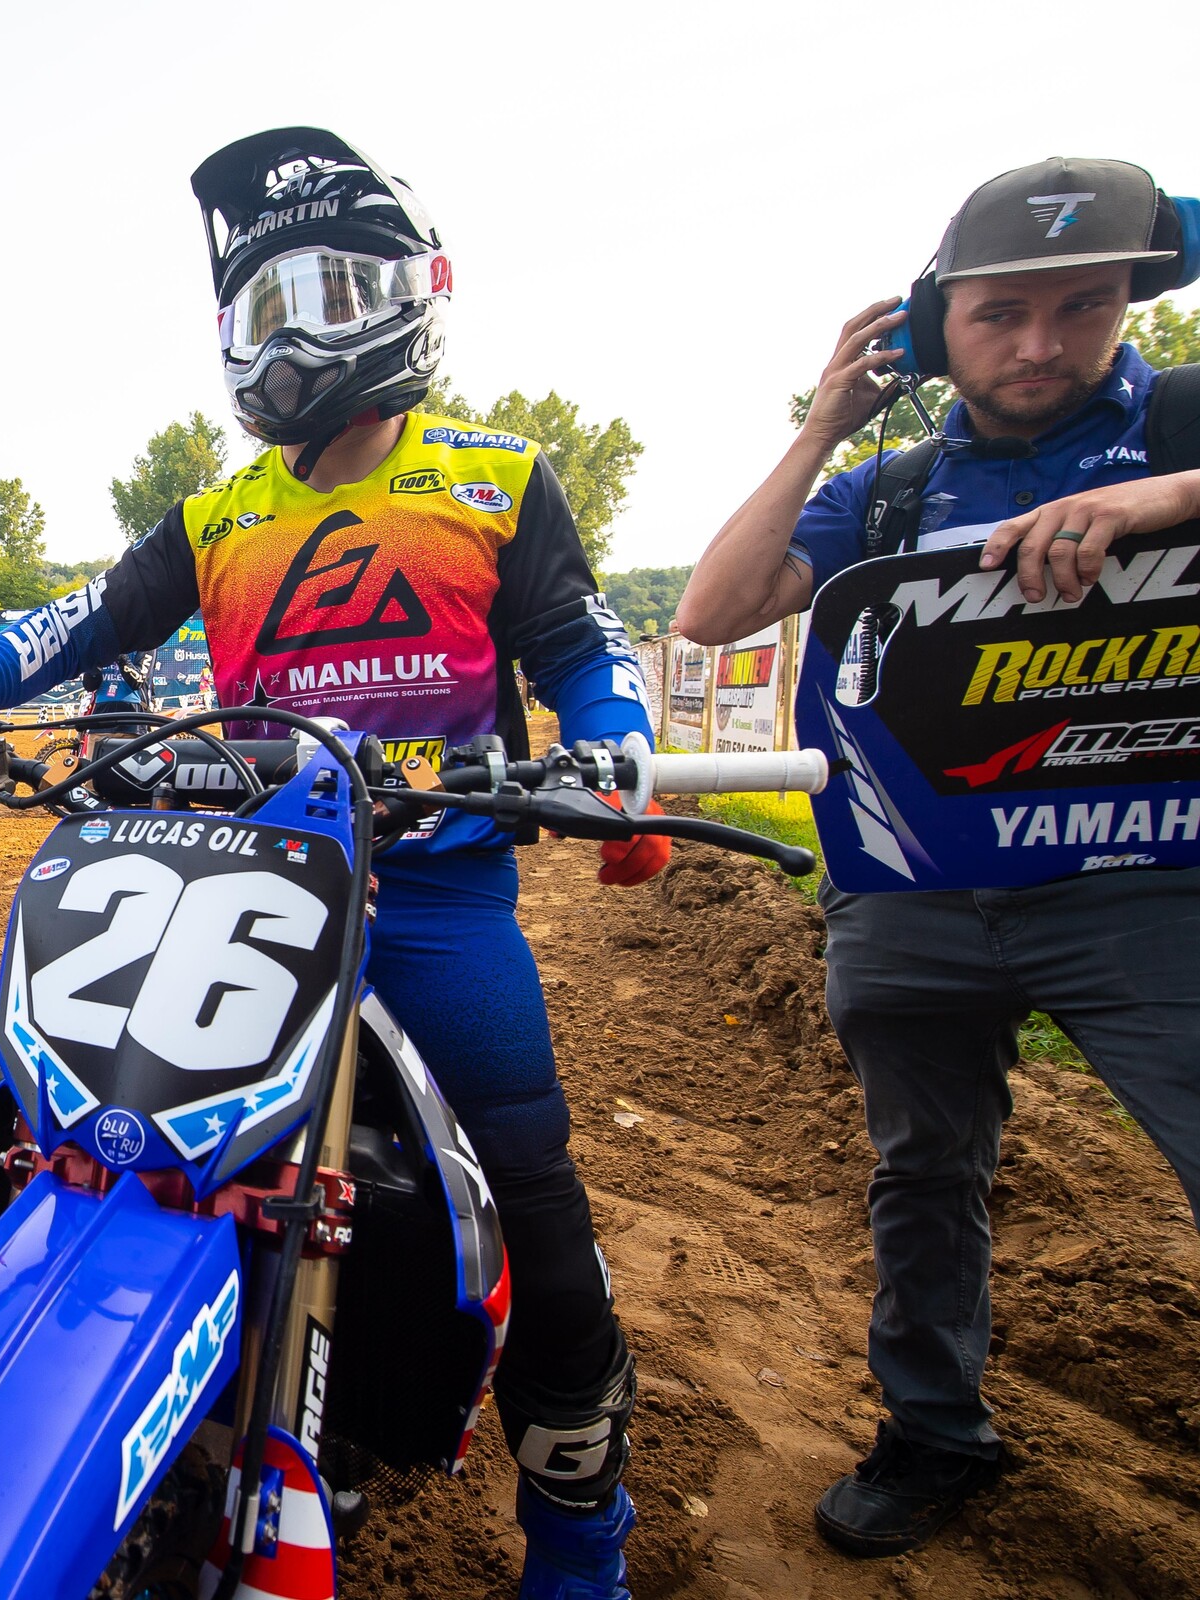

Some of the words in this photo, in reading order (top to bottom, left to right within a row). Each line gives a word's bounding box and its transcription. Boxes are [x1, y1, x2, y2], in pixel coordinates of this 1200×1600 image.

[246, 199, 340, 243] MARTIN
[449, 430, 524, 448] YAMAHA
[1106, 446, 1147, 463] YAM
[398, 473, 440, 489] 100%
[459, 488, 504, 502] AMA
[288, 653, 451, 691] MANLUK
[292, 698, 322, 708] GLOBAL
[323, 690, 399, 703] MANUFACTURING
[401, 687, 451, 697] SOLUTIONS
[1042, 752, 1131, 768] RACING
[990, 797, 1200, 848] YAMAH
[112, 819, 205, 847] LUCAS
[209, 826, 258, 857] OIL
[273, 838, 310, 853] AMA
[287, 850, 307, 860] PRO
[31, 853, 329, 1071] 26
[300, 1326, 333, 1466] RGE
